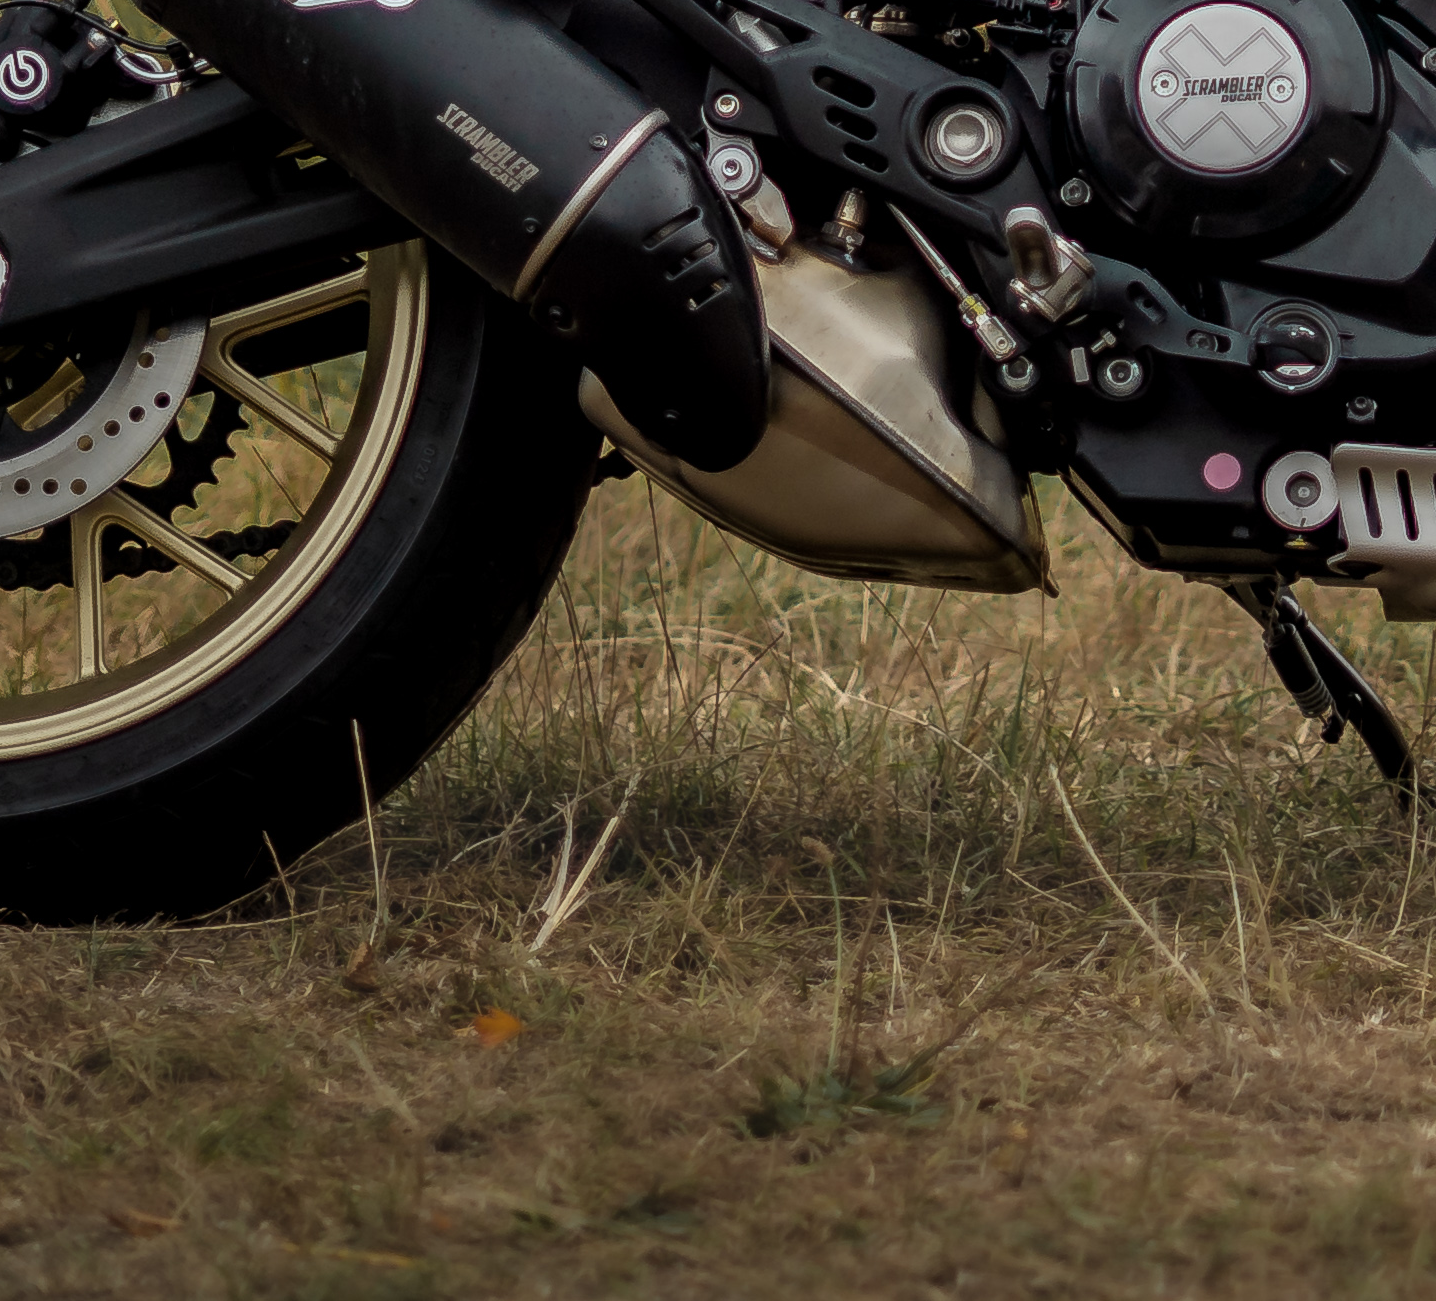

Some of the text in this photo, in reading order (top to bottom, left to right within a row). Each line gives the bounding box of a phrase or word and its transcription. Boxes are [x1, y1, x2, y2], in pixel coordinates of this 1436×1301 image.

[1181, 75, 1265, 97] SCRAMBLER
[1220, 92, 1263, 104] DUCATI
[436, 103, 540, 185] SCRAMBLER
[470, 152, 523, 193] DUCATI
